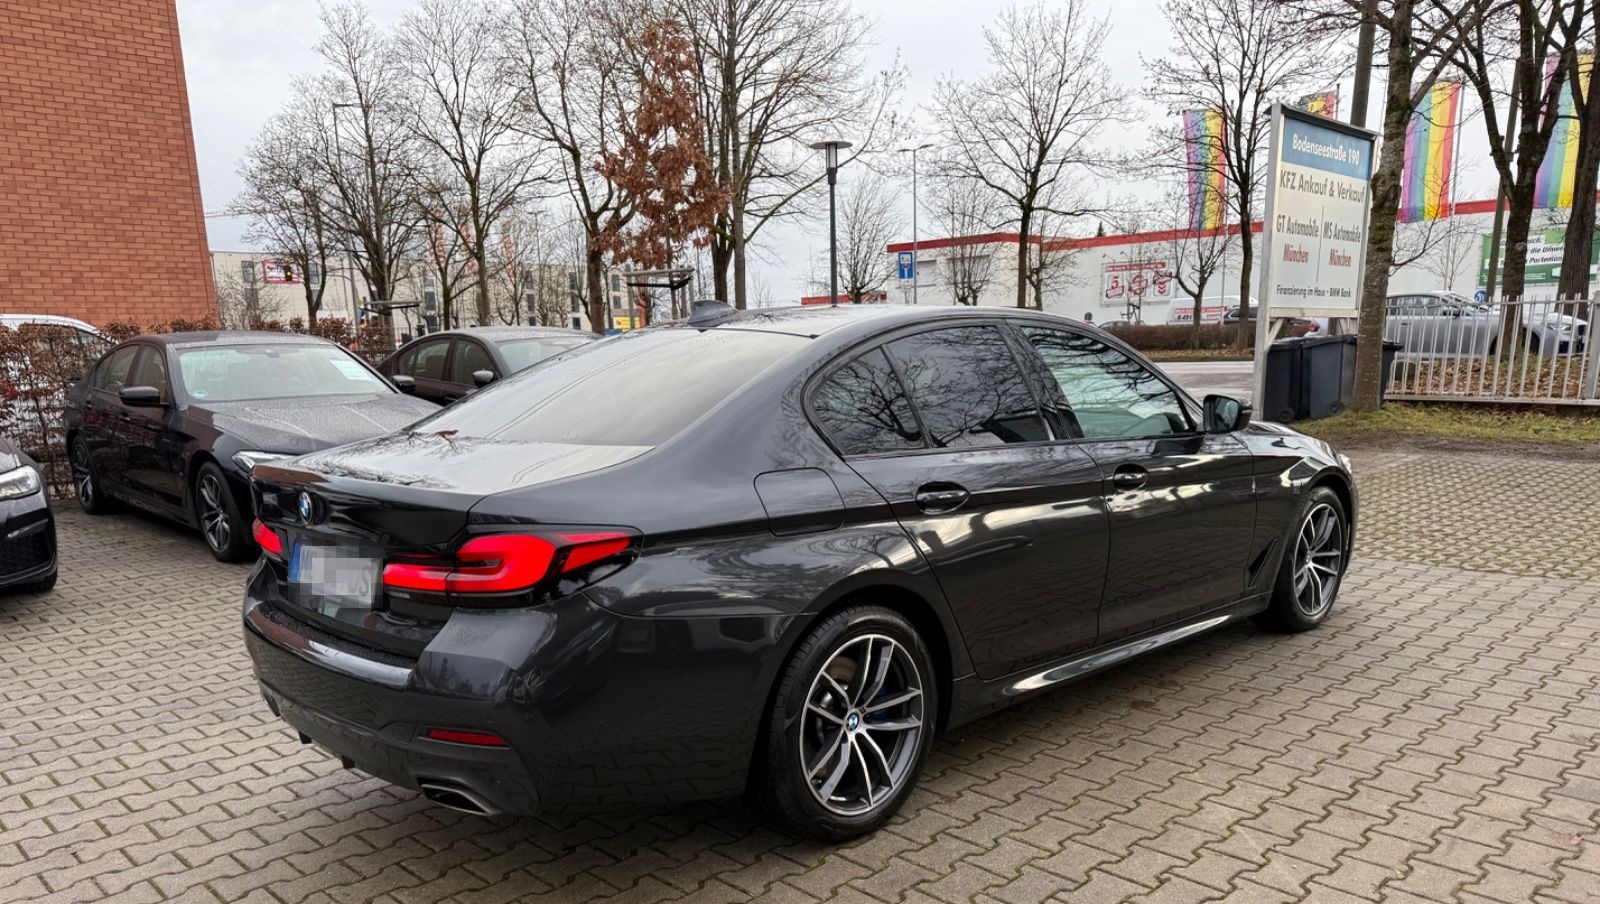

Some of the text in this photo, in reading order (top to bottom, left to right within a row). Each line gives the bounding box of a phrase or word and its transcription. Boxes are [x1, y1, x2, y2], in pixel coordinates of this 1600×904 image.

[1292, 133, 1360, 165] Bodenseestraße 190
[1280, 169, 1365, 203] KFZ Ankauf & Verkauf
[1276, 214, 1320, 238] GT Automobile
[1323, 221, 1361, 243] MS Automobile
[1283, 243, 1309, 263] München
[1329, 248, 1351, 267] München
[1276, 284, 1307, 299] Finanzierung
[1314, 287, 1325, 297] Haus
[1329, 287, 1341, 297] BMW
